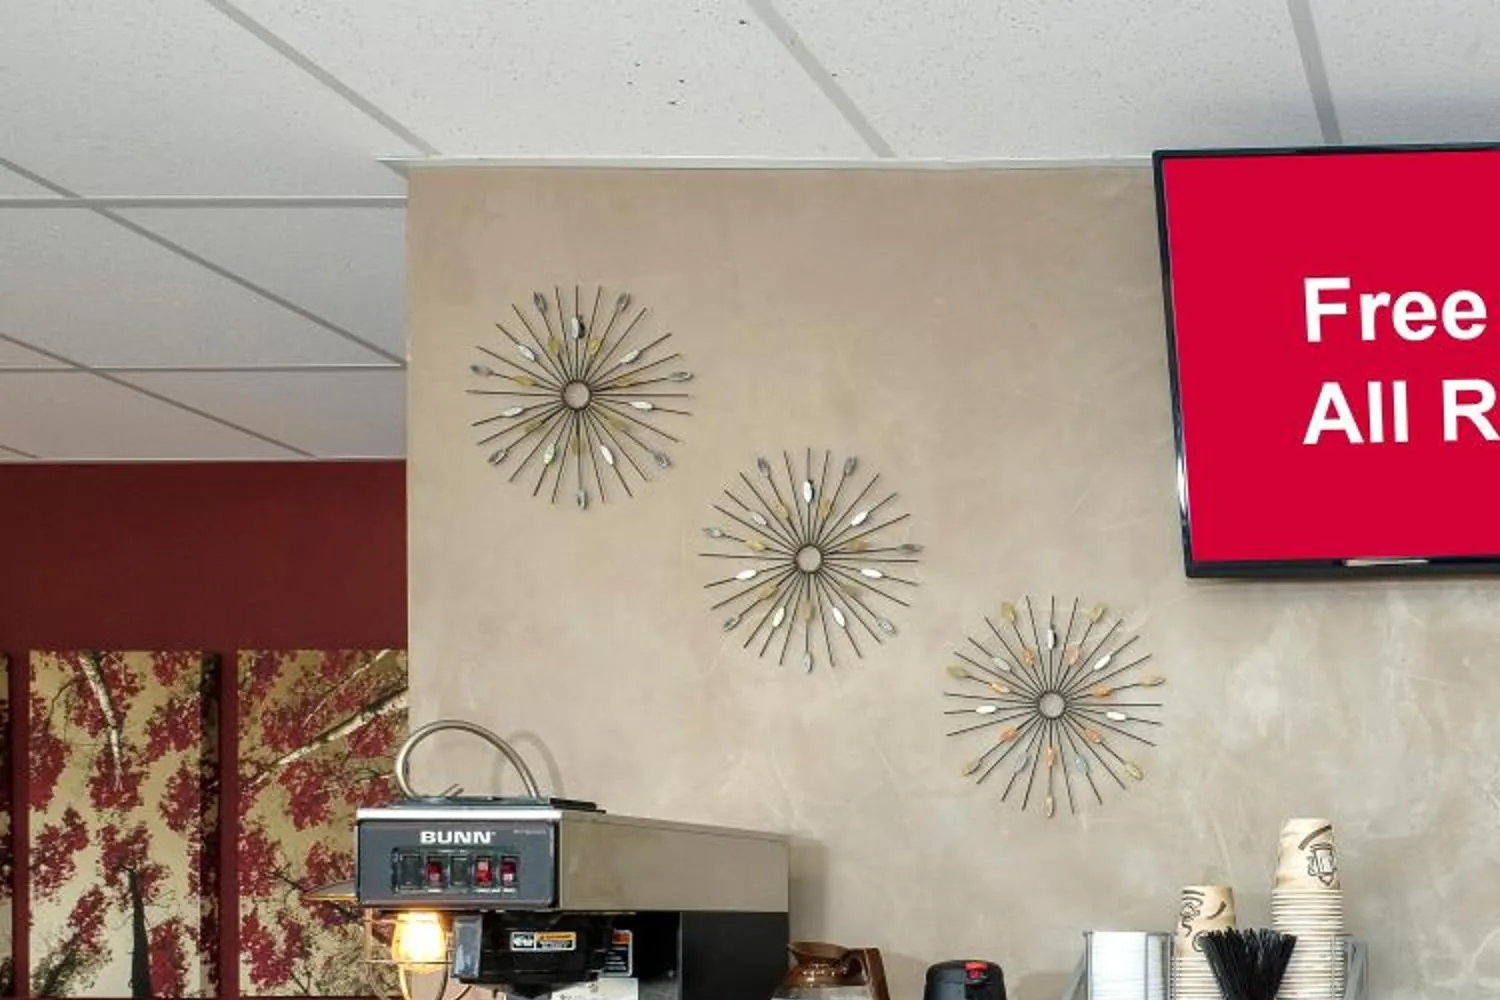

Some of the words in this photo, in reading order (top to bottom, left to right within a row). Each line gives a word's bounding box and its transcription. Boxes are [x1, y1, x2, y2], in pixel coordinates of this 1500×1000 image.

[1303, 276, 1487, 342] Free
[1302, 381, 1408, 444] All
[420, 831, 492, 844] BUNN
